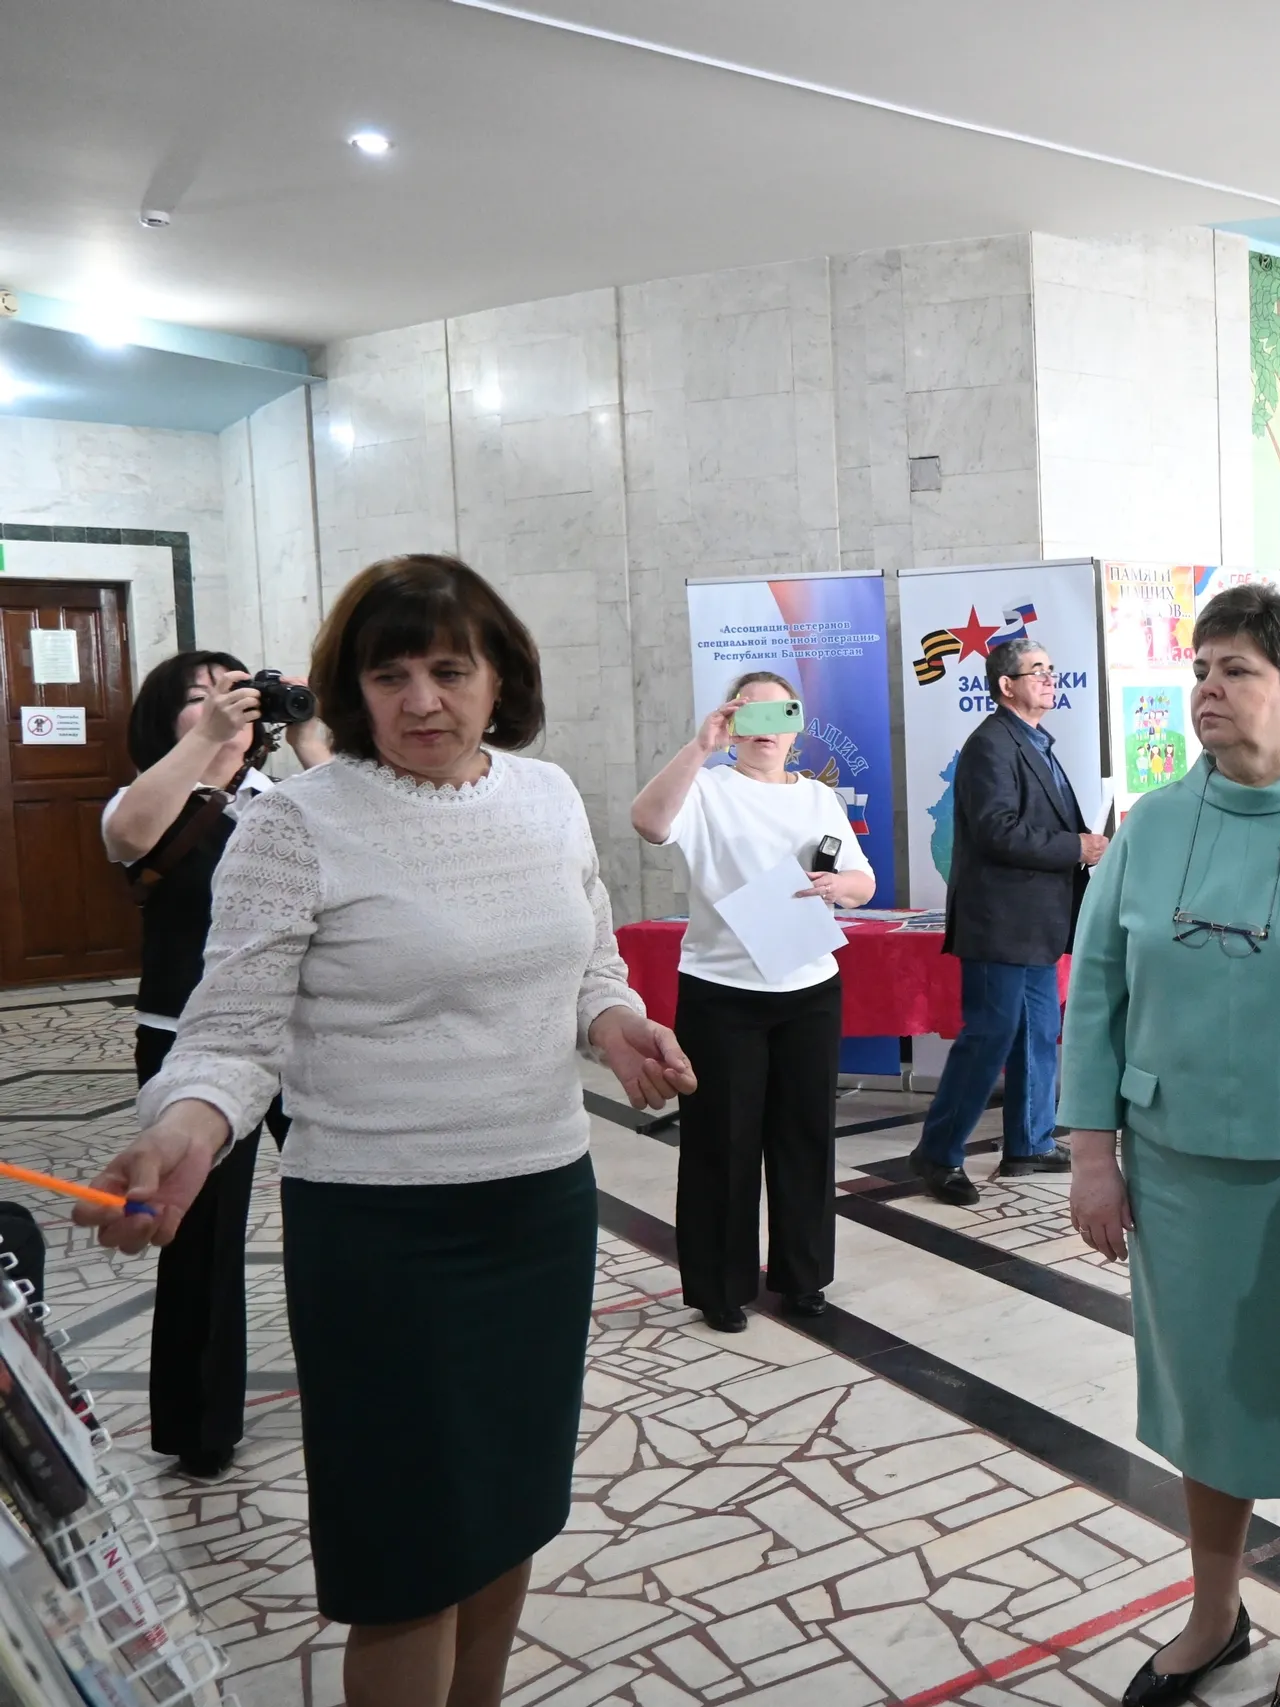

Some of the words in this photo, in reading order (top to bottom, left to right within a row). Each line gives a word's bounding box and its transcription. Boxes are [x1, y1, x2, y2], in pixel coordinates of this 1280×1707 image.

[1110, 566, 1172, 582] ПАМЯТИ
[793, 621, 851, 632] ветеранов
[697, 635, 767, 649] специальной
[771, 634, 817, 646] военной
[713, 649, 778, 662] Республики
[781, 647, 864, 660] Башкортостан
